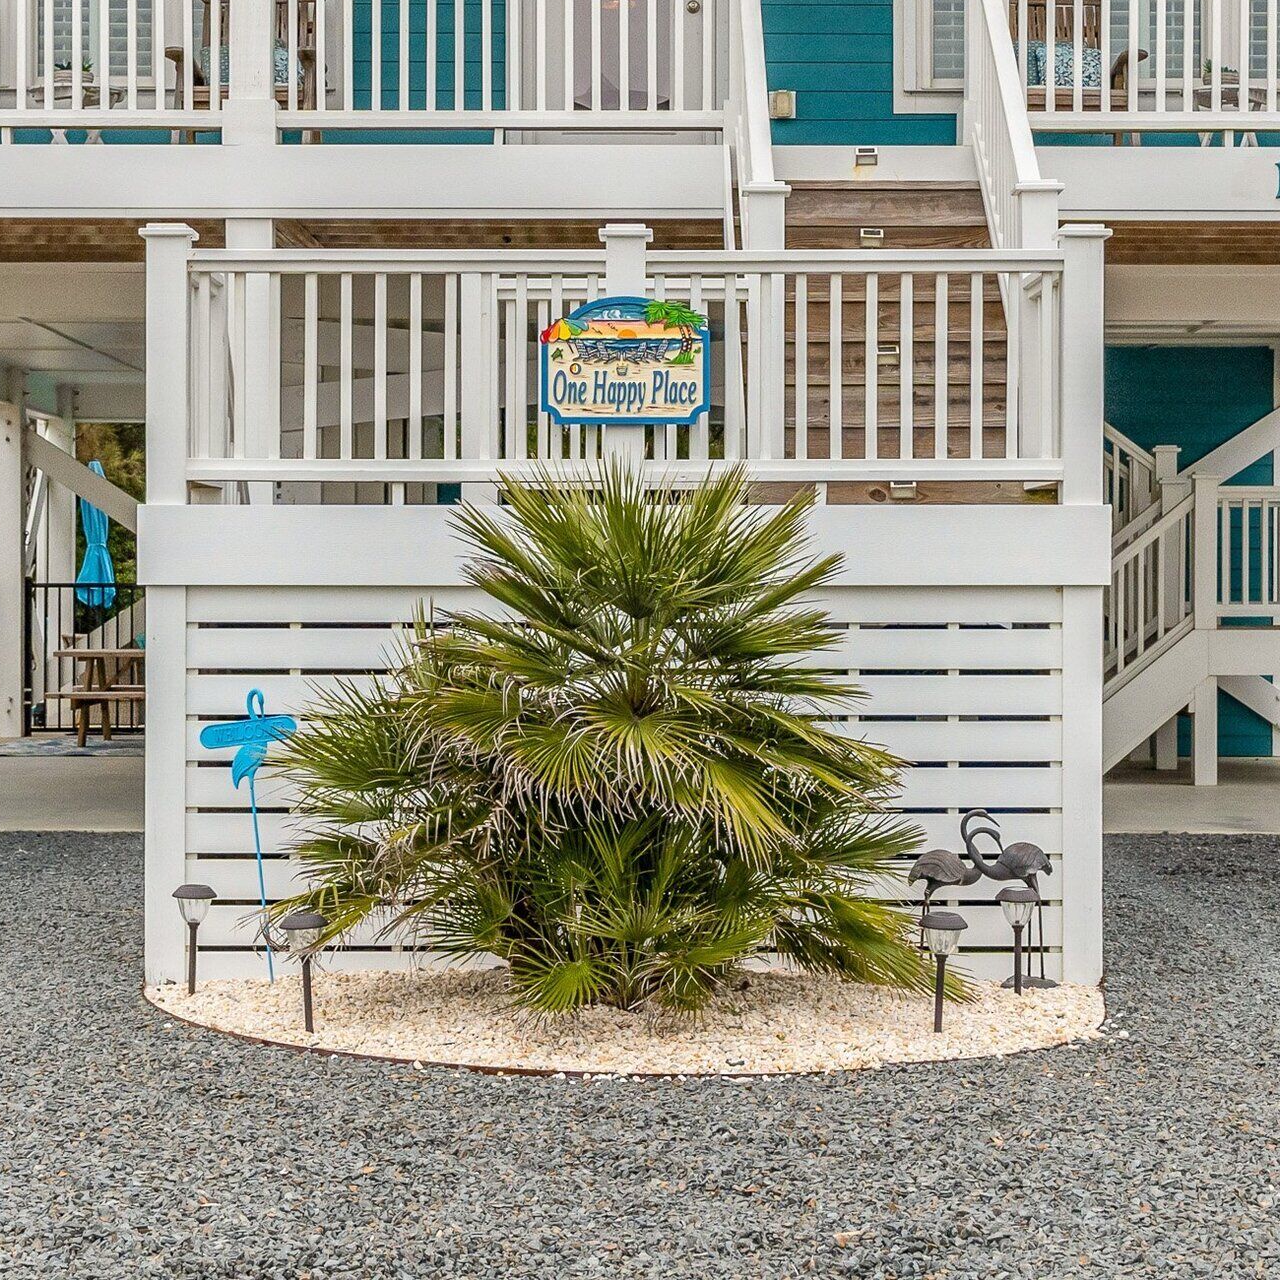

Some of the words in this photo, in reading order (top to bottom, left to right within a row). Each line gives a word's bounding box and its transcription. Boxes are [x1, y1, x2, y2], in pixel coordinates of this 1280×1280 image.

[553, 370, 587, 405] One
[593, 370, 647, 412] Happy
[651, 370, 697, 405] Place
